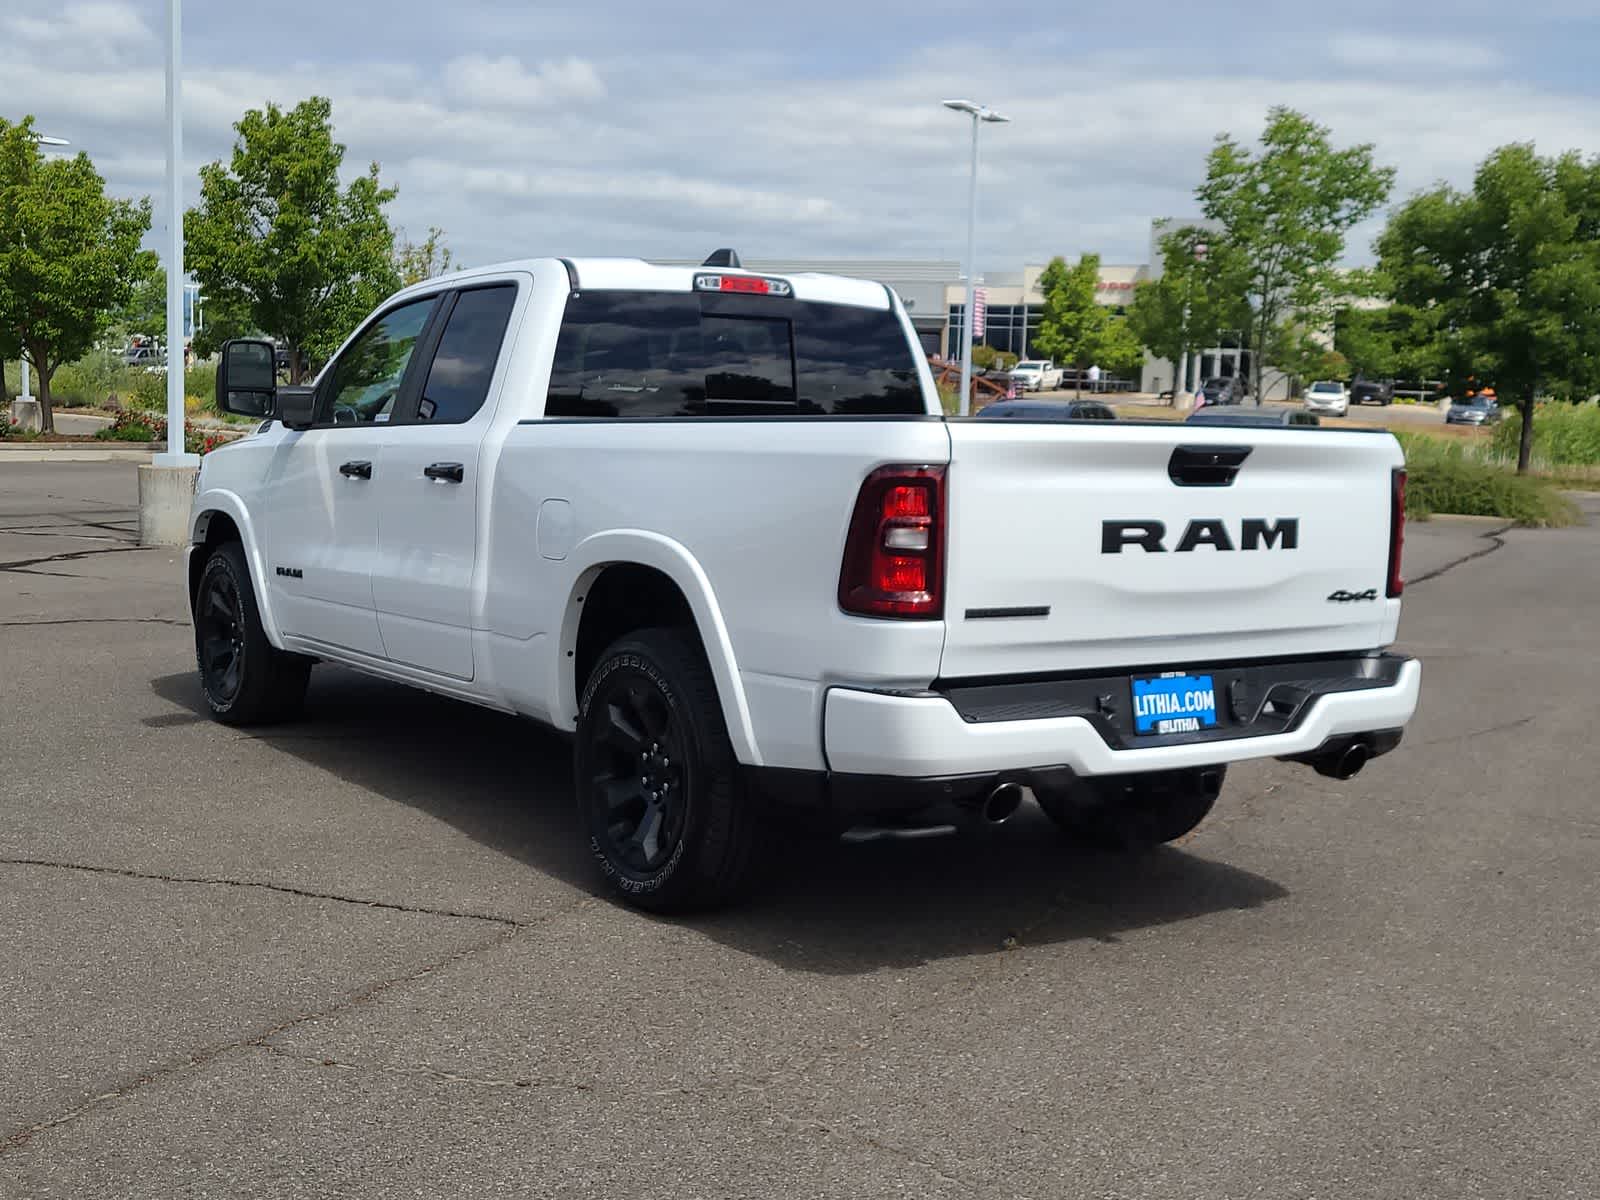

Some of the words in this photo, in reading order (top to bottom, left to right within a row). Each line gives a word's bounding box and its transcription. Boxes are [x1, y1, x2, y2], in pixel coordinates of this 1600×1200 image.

[1101, 517, 1300, 554] RAM
[276, 566, 303, 579] RAM
[1134, 689, 1215, 717] LITHIA.COM
[1169, 717, 1200, 733] LITHIA
